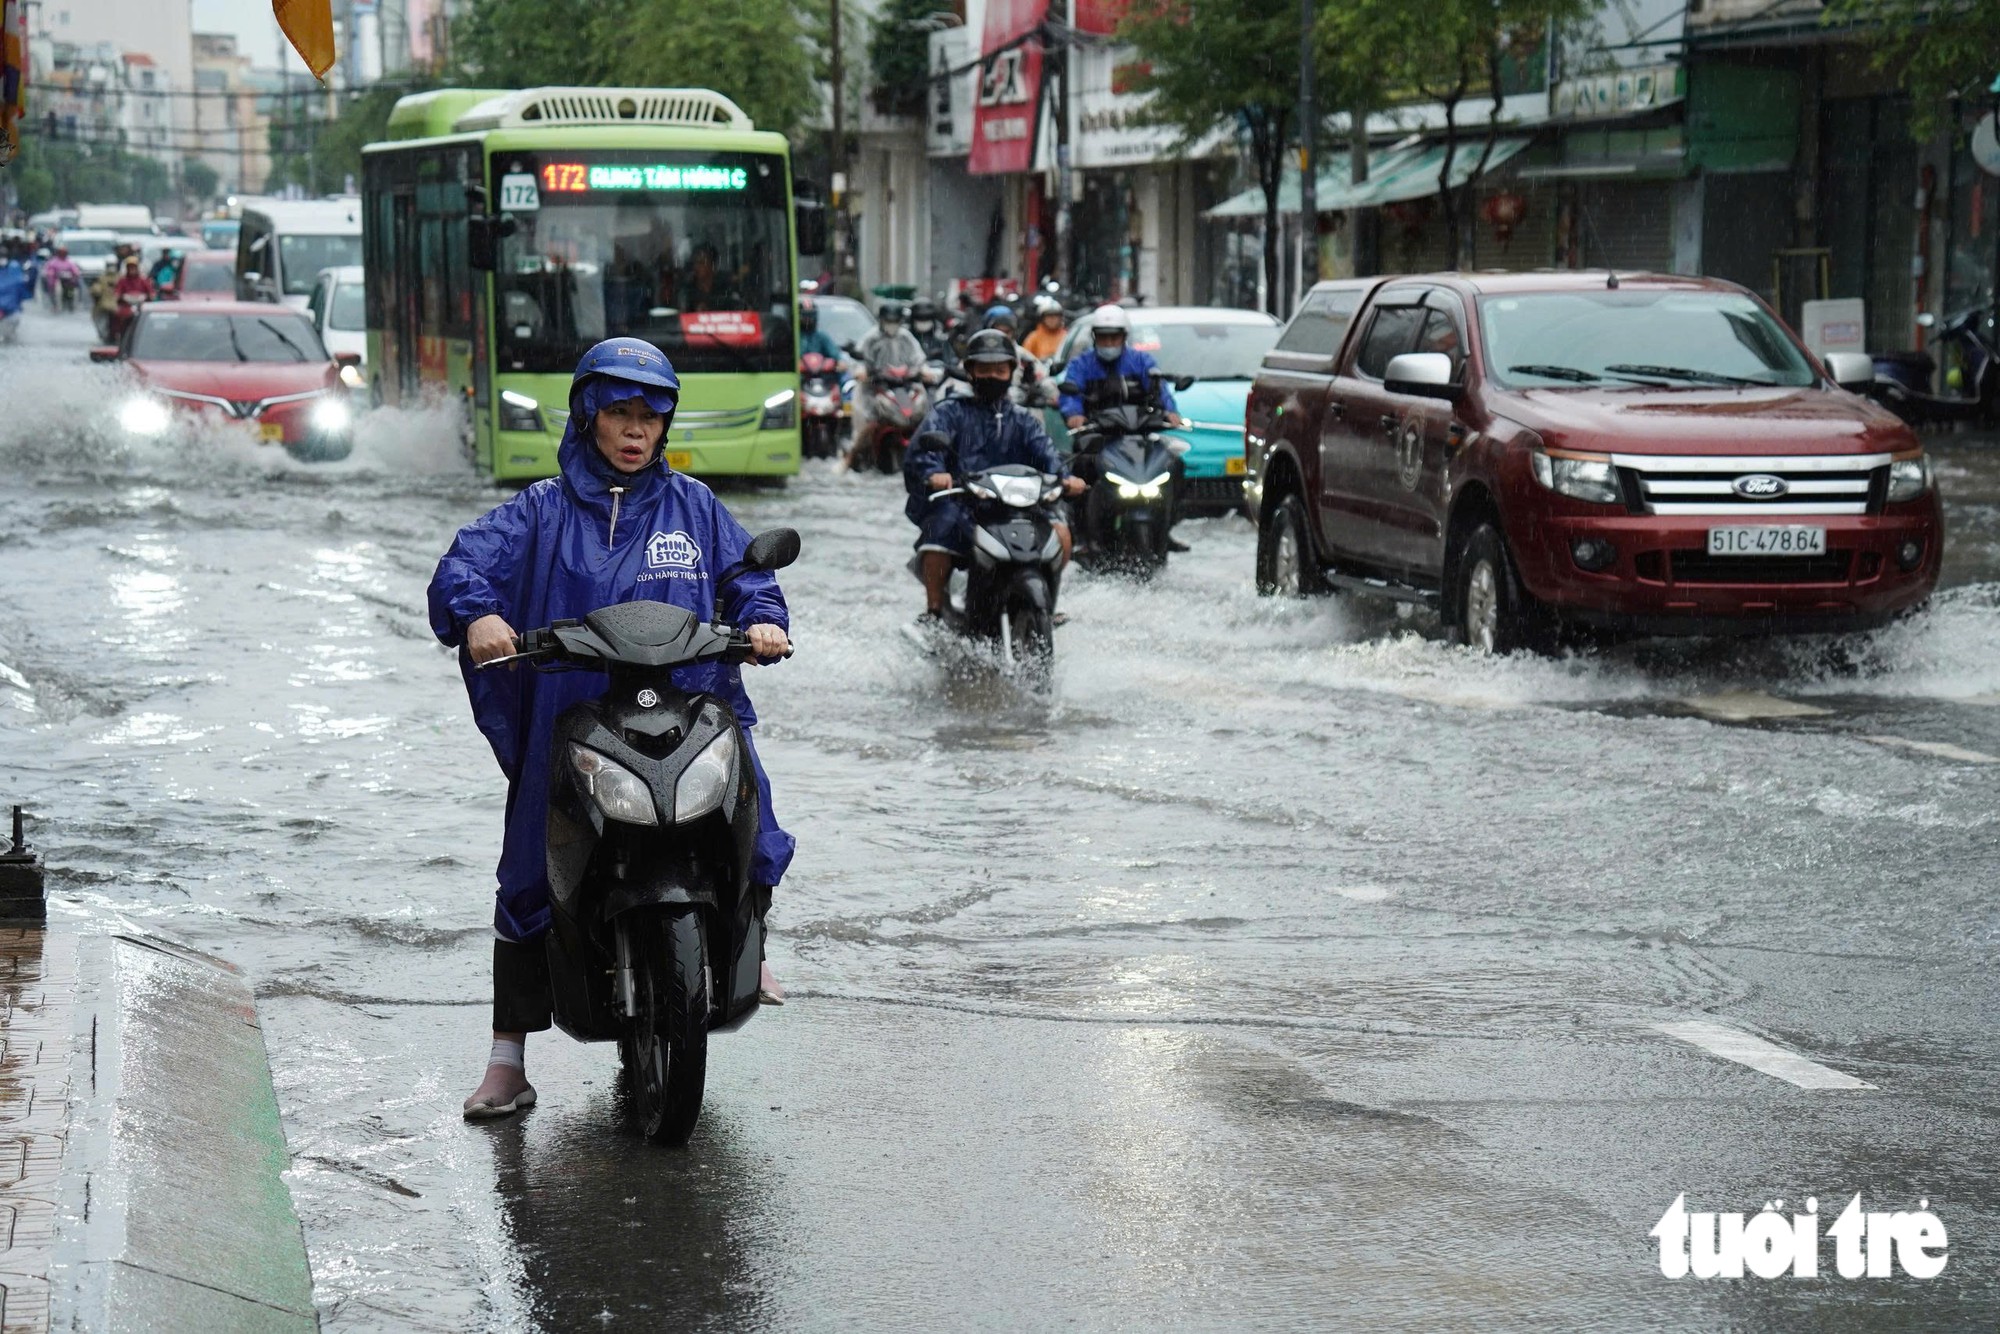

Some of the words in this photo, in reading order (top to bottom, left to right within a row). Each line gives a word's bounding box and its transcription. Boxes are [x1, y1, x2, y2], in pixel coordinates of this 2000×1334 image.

[544, 164, 586, 190] 172
[505, 186, 535, 203] 172
[1745, 478, 1778, 493] Ford
[656, 540, 687, 552] MINI
[1713, 530, 1820, 551] 51C-478.64
[656, 550, 689, 562] STOP
[655, 570, 678, 579] HÀNG
